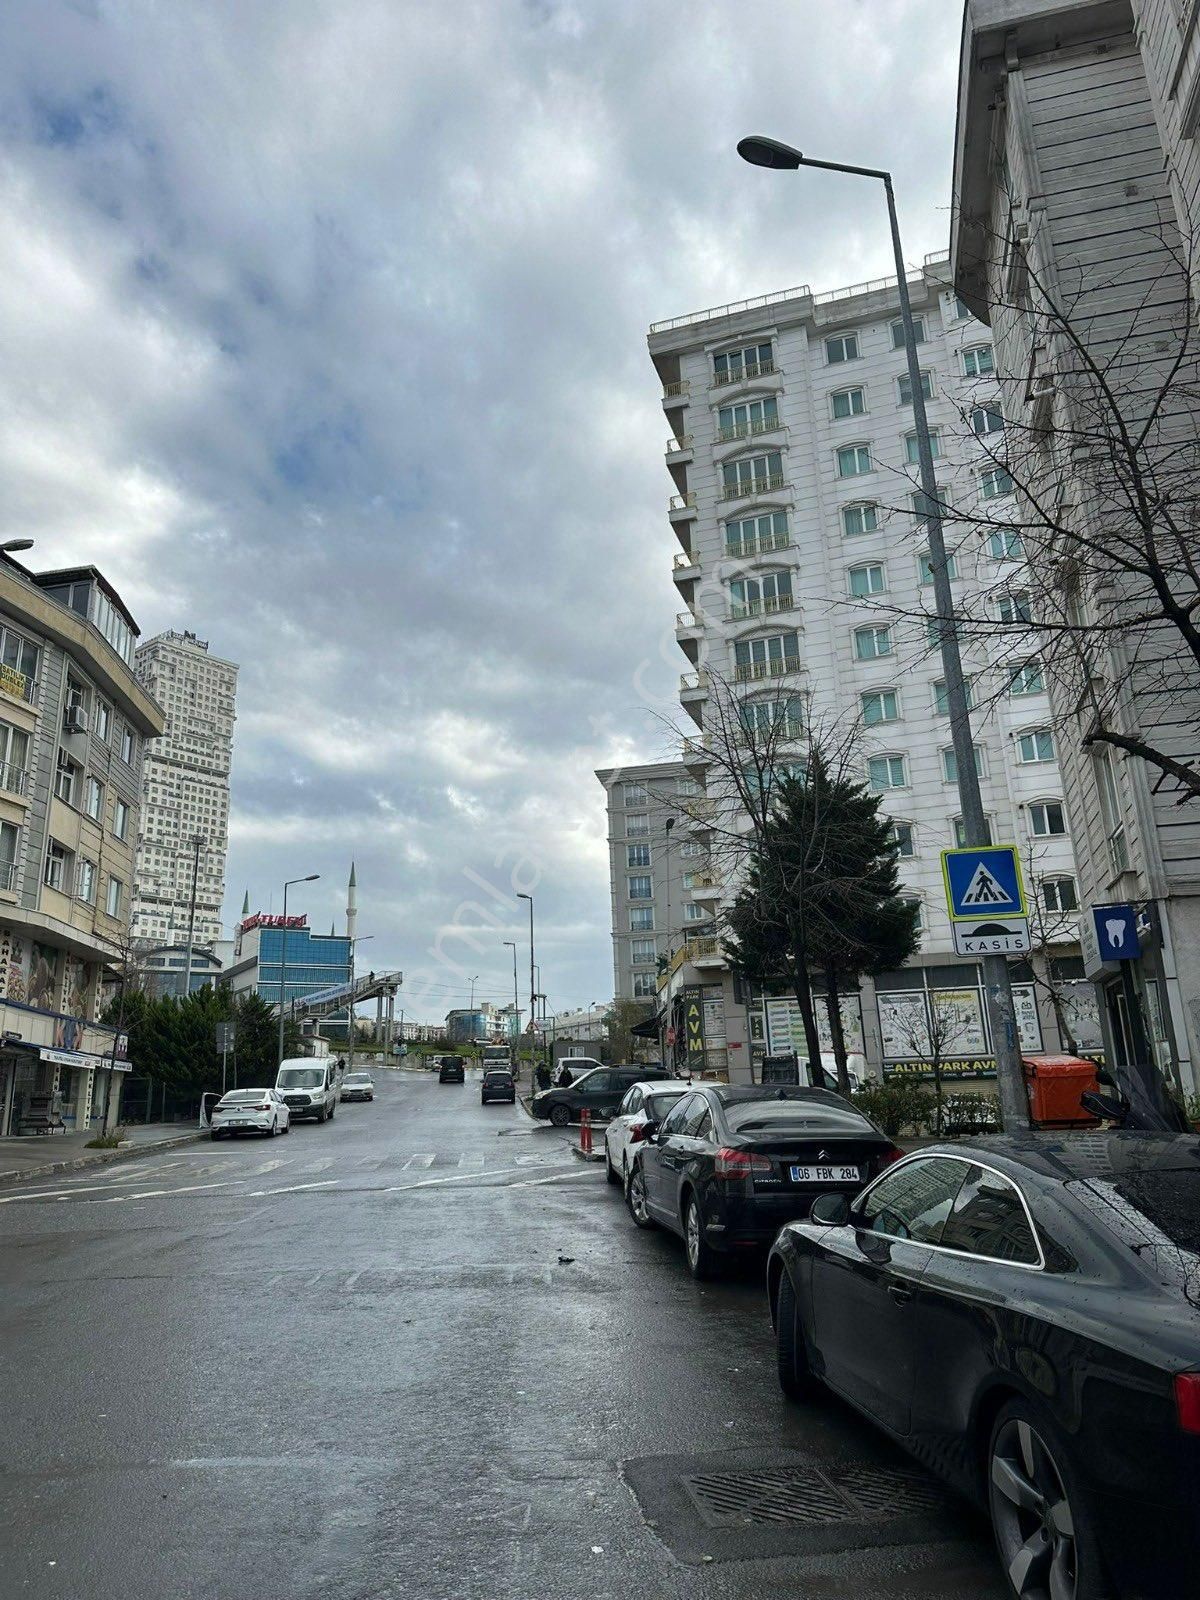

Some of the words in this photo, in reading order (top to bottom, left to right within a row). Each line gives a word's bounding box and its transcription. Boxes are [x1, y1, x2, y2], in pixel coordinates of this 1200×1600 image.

[964, 937, 1024, 952] KASİS
[688, 1004, 703, 1051] AVM
[895, 1062, 932, 1073] ALTIN
[798, 1168, 810, 1180] 06
[817, 1168, 834, 1180] FBK
[840, 1167, 858, 1180] 284
